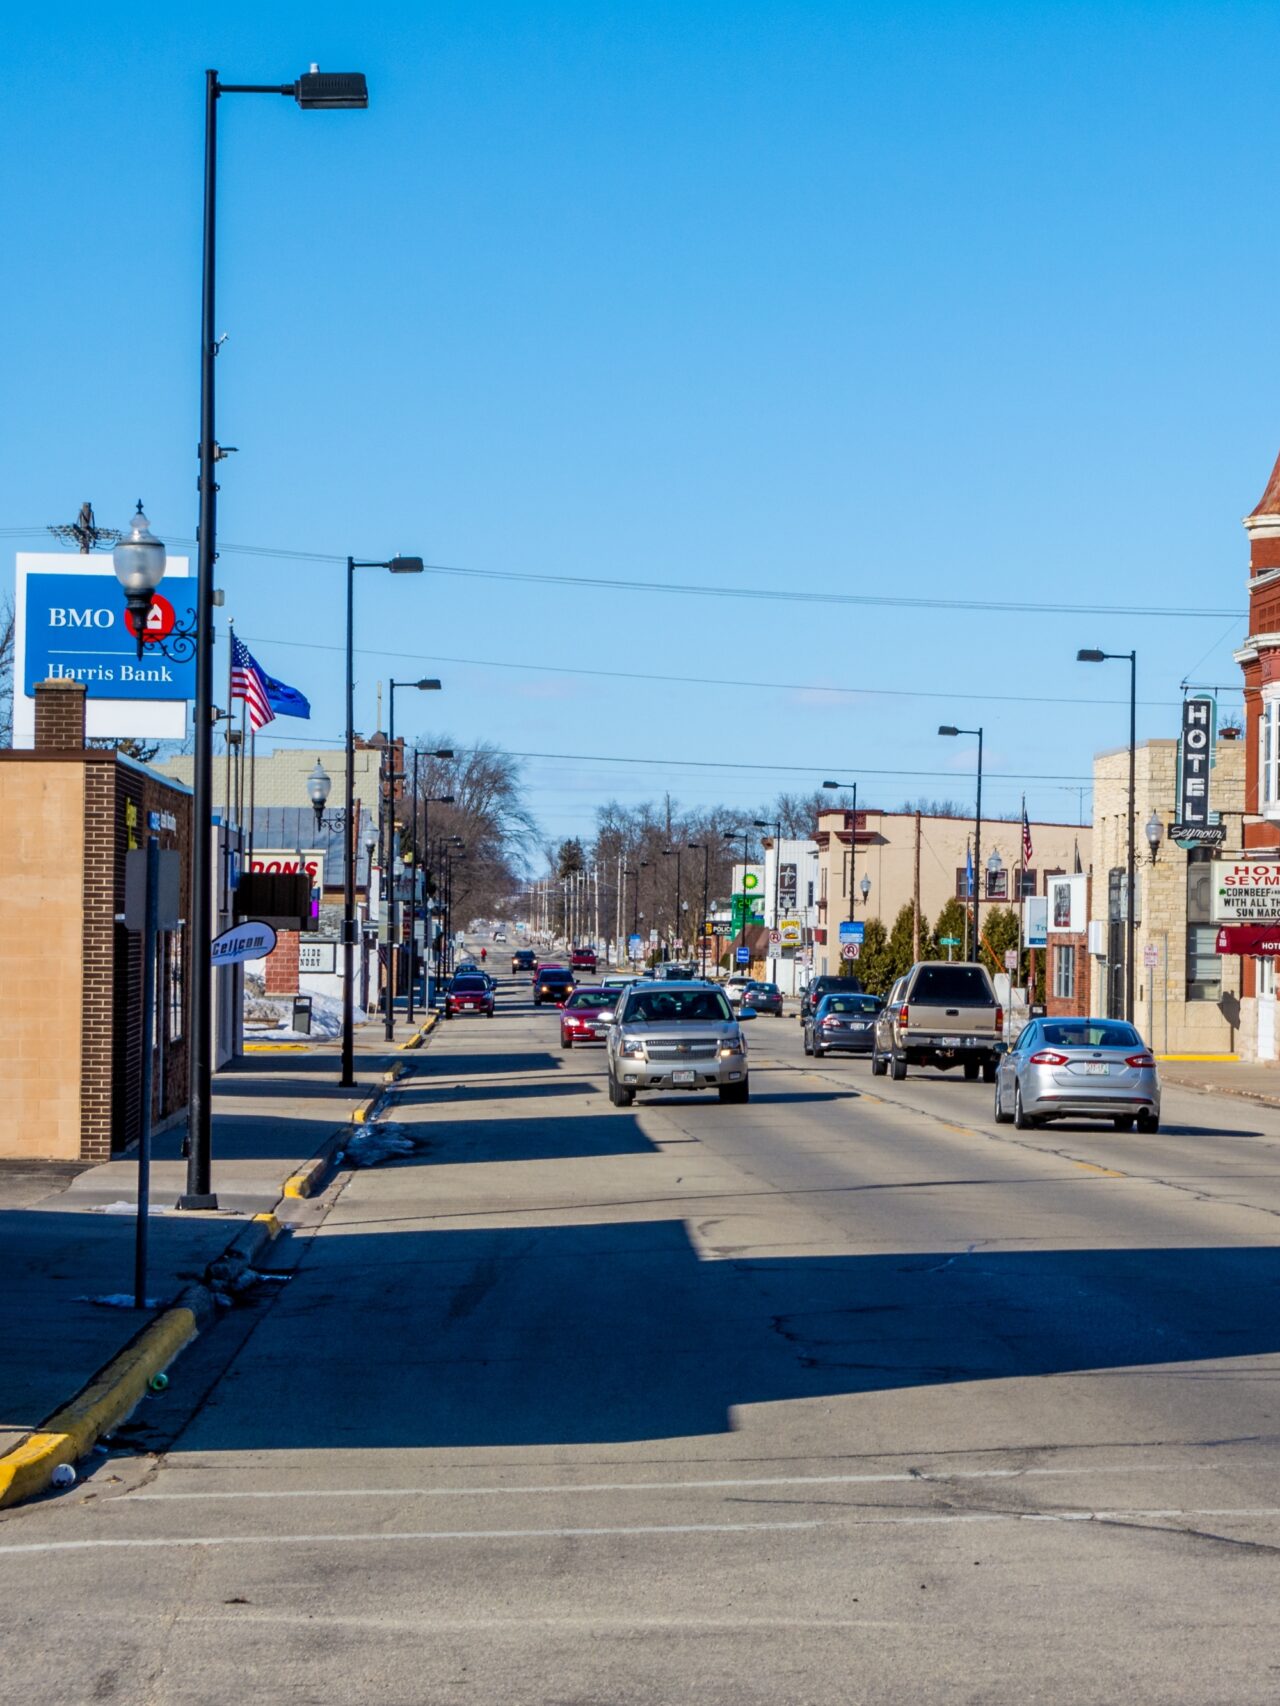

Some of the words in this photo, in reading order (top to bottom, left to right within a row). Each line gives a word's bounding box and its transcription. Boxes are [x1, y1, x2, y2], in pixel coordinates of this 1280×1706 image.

[48, 607, 115, 628] BMO
[47, 664, 114, 681] Harris
[120, 665, 173, 682] Bank
[1185, 705, 1208, 821] HOTEL
[1170, 826, 1225, 841] Seymour
[1226, 888, 1271, 897] CORNBEEF
[1224, 898, 1246, 907] WITH
[1250, 898, 1267, 907] ALL
[1236, 908, 1254, 917] SUN
[212, 936, 265, 956] Cellcom
[299, 948, 321, 957] SIDE
[300, 958, 321, 967] NDRY
